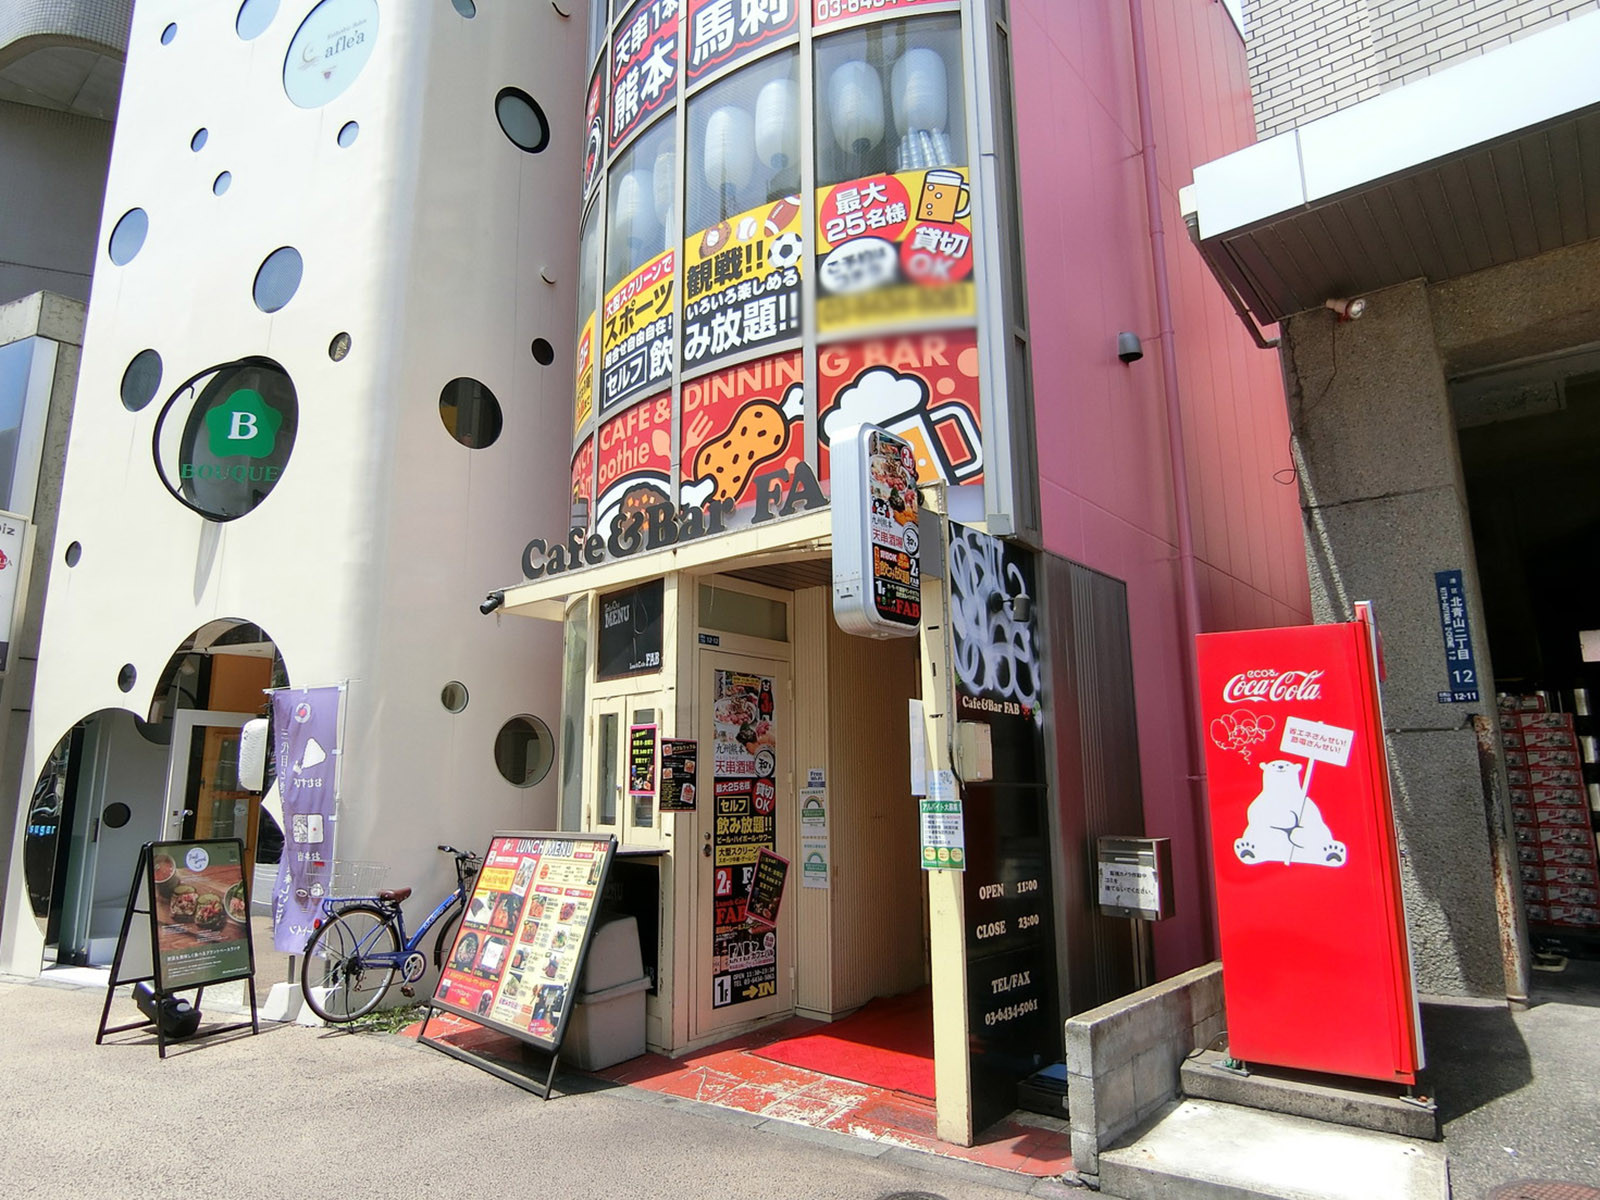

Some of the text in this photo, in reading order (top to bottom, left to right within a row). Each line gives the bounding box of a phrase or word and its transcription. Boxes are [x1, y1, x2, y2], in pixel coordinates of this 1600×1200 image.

[693, 0, 789, 66] 馬刺
[613, 38, 674, 138] 熊本
[835, 182, 888, 216] 最大
[825, 202, 908, 243] 25名様
[911, 226, 970, 259] 貸切
[687, 239, 764, 300] 観戦!!
[606, 252, 672, 319] 大型スクリーンで
[686, 267, 800, 321] いろいろ楽しめる
[604, 279, 674, 349] スポーツ
[606, 355, 645, 398] セルフ
[600, 404, 651, 451] CAFE
[654, 397, 671, 425] &
[862, 335, 950, 373] BAR
[227, 411, 259, 440] B
[751, 460, 830, 525] FA
[604, 604, 631, 629] MENU
[896, 599, 920, 619] FAB
[645, 651, 660, 667] FAB
[1223, 669, 1326, 704] Coca-Cola
[1452, 669, 1474, 683] 12
[962, 695, 1020, 716] Cafe&Bar FAB
[1453, 691, 1477, 701] 12-11
[716, 760, 756, 775] 天串酒場
[721, 799, 746, 813] セルフ
[755, 798, 770, 812] OK
[716, 816, 773, 835] 飲み放題!!
[515, 840, 544, 855] LUNCH
[545, 841, 574, 858] MENU
[592, 841, 609, 852] FAB
[717, 870, 731, 895] 2F
[979, 879, 1038, 900] OPEN 11:00
[715, 904, 748, 925] FAB
[976, 914, 1039, 939] CLOSE 23:00
[717, 978, 729, 1002] 1F
[758, 980, 775, 997] IN
[991, 970, 1031, 994] TEL/FAX
[985, 998, 1038, 1026] 03-6434-5061
